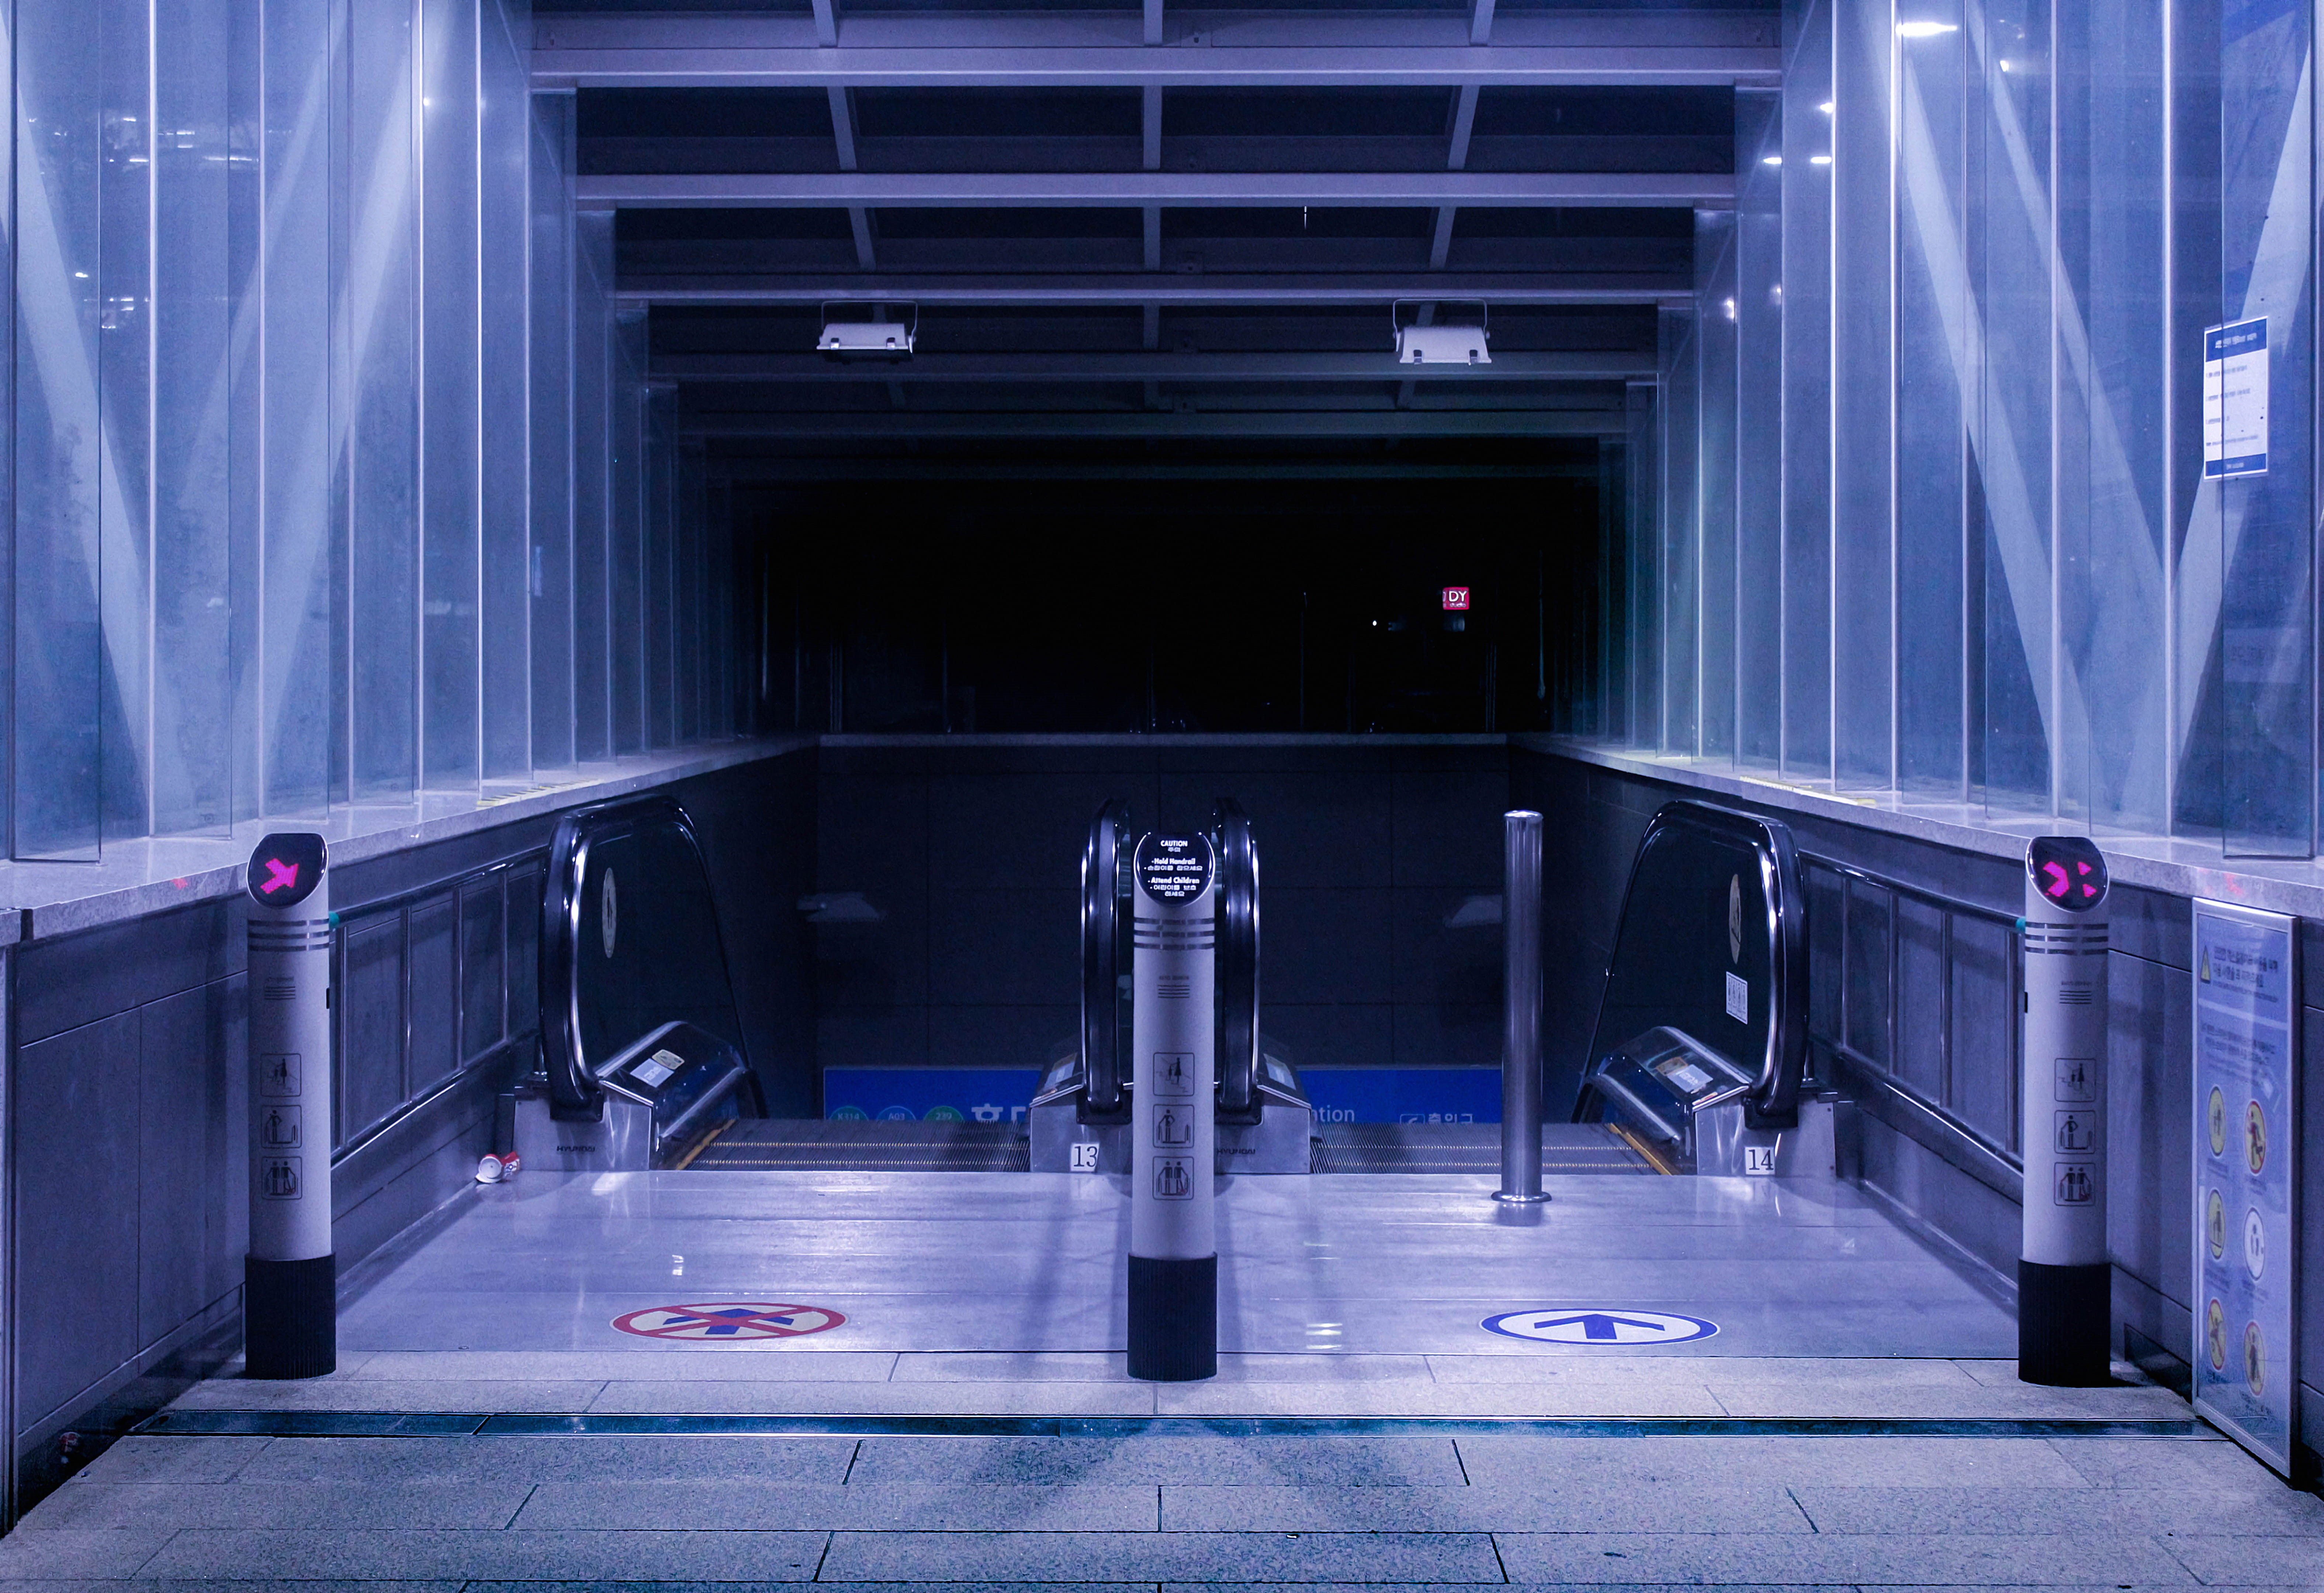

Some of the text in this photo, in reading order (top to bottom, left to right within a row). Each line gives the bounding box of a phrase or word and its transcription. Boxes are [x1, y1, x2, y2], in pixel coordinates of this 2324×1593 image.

[1449, 591, 1467, 602] DY
[1074, 1146, 1098, 1168] 13
[1749, 1149, 1774, 1171] 14
